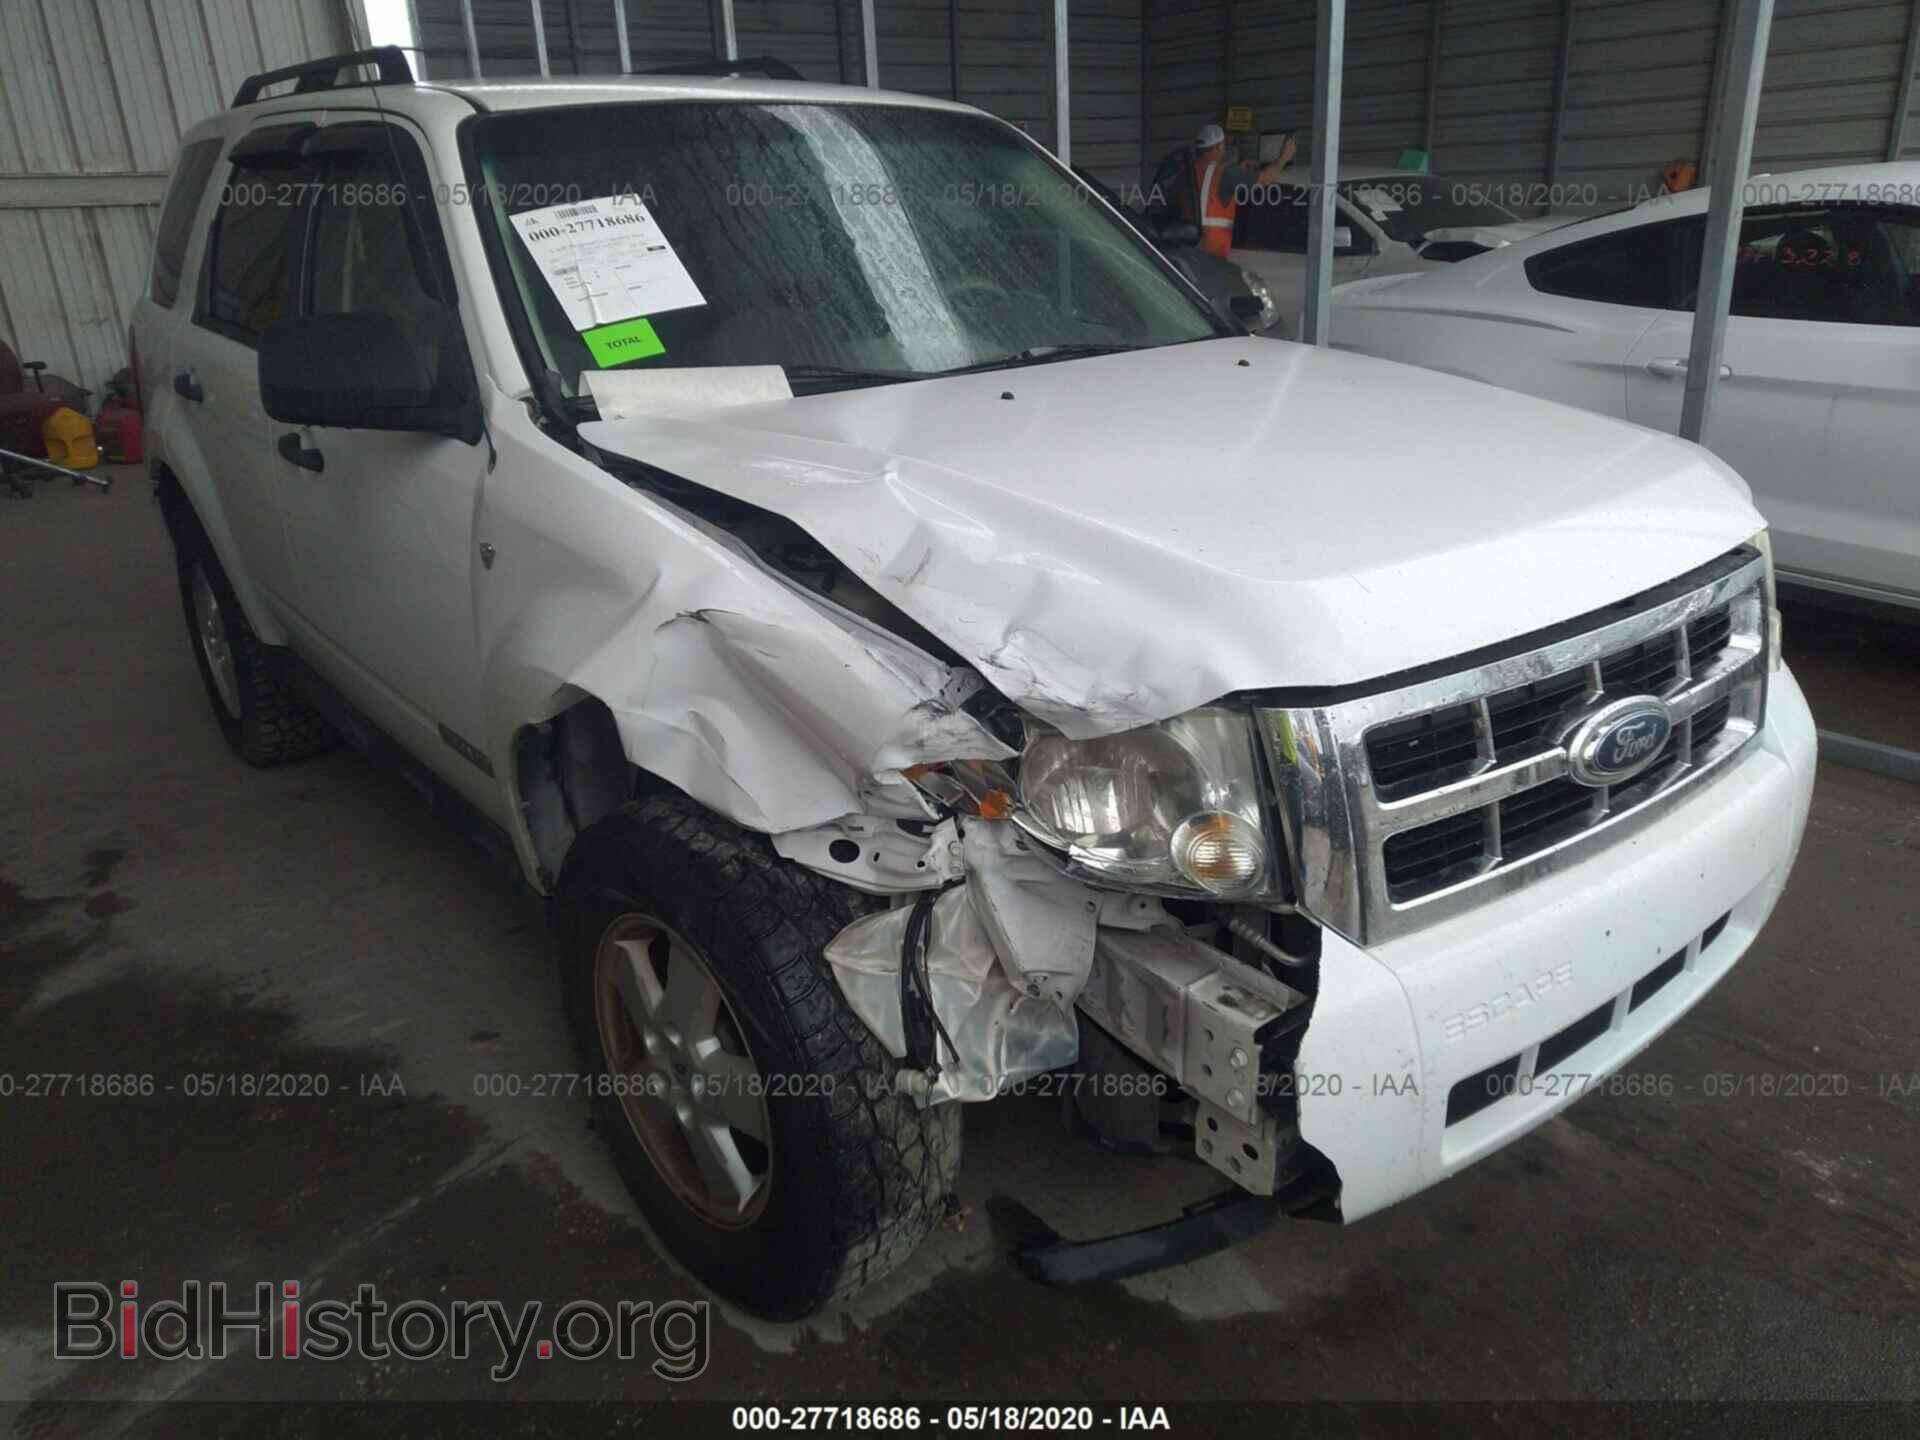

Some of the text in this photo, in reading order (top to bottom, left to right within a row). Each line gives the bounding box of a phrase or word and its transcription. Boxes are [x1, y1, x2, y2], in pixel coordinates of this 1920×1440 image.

[528, 213, 646, 242] 000-27718686
[605, 335, 643, 350] TOTAL
[1611, 720, 1658, 764] Ford
[1442, 960, 1574, 1040] ESCAPE
